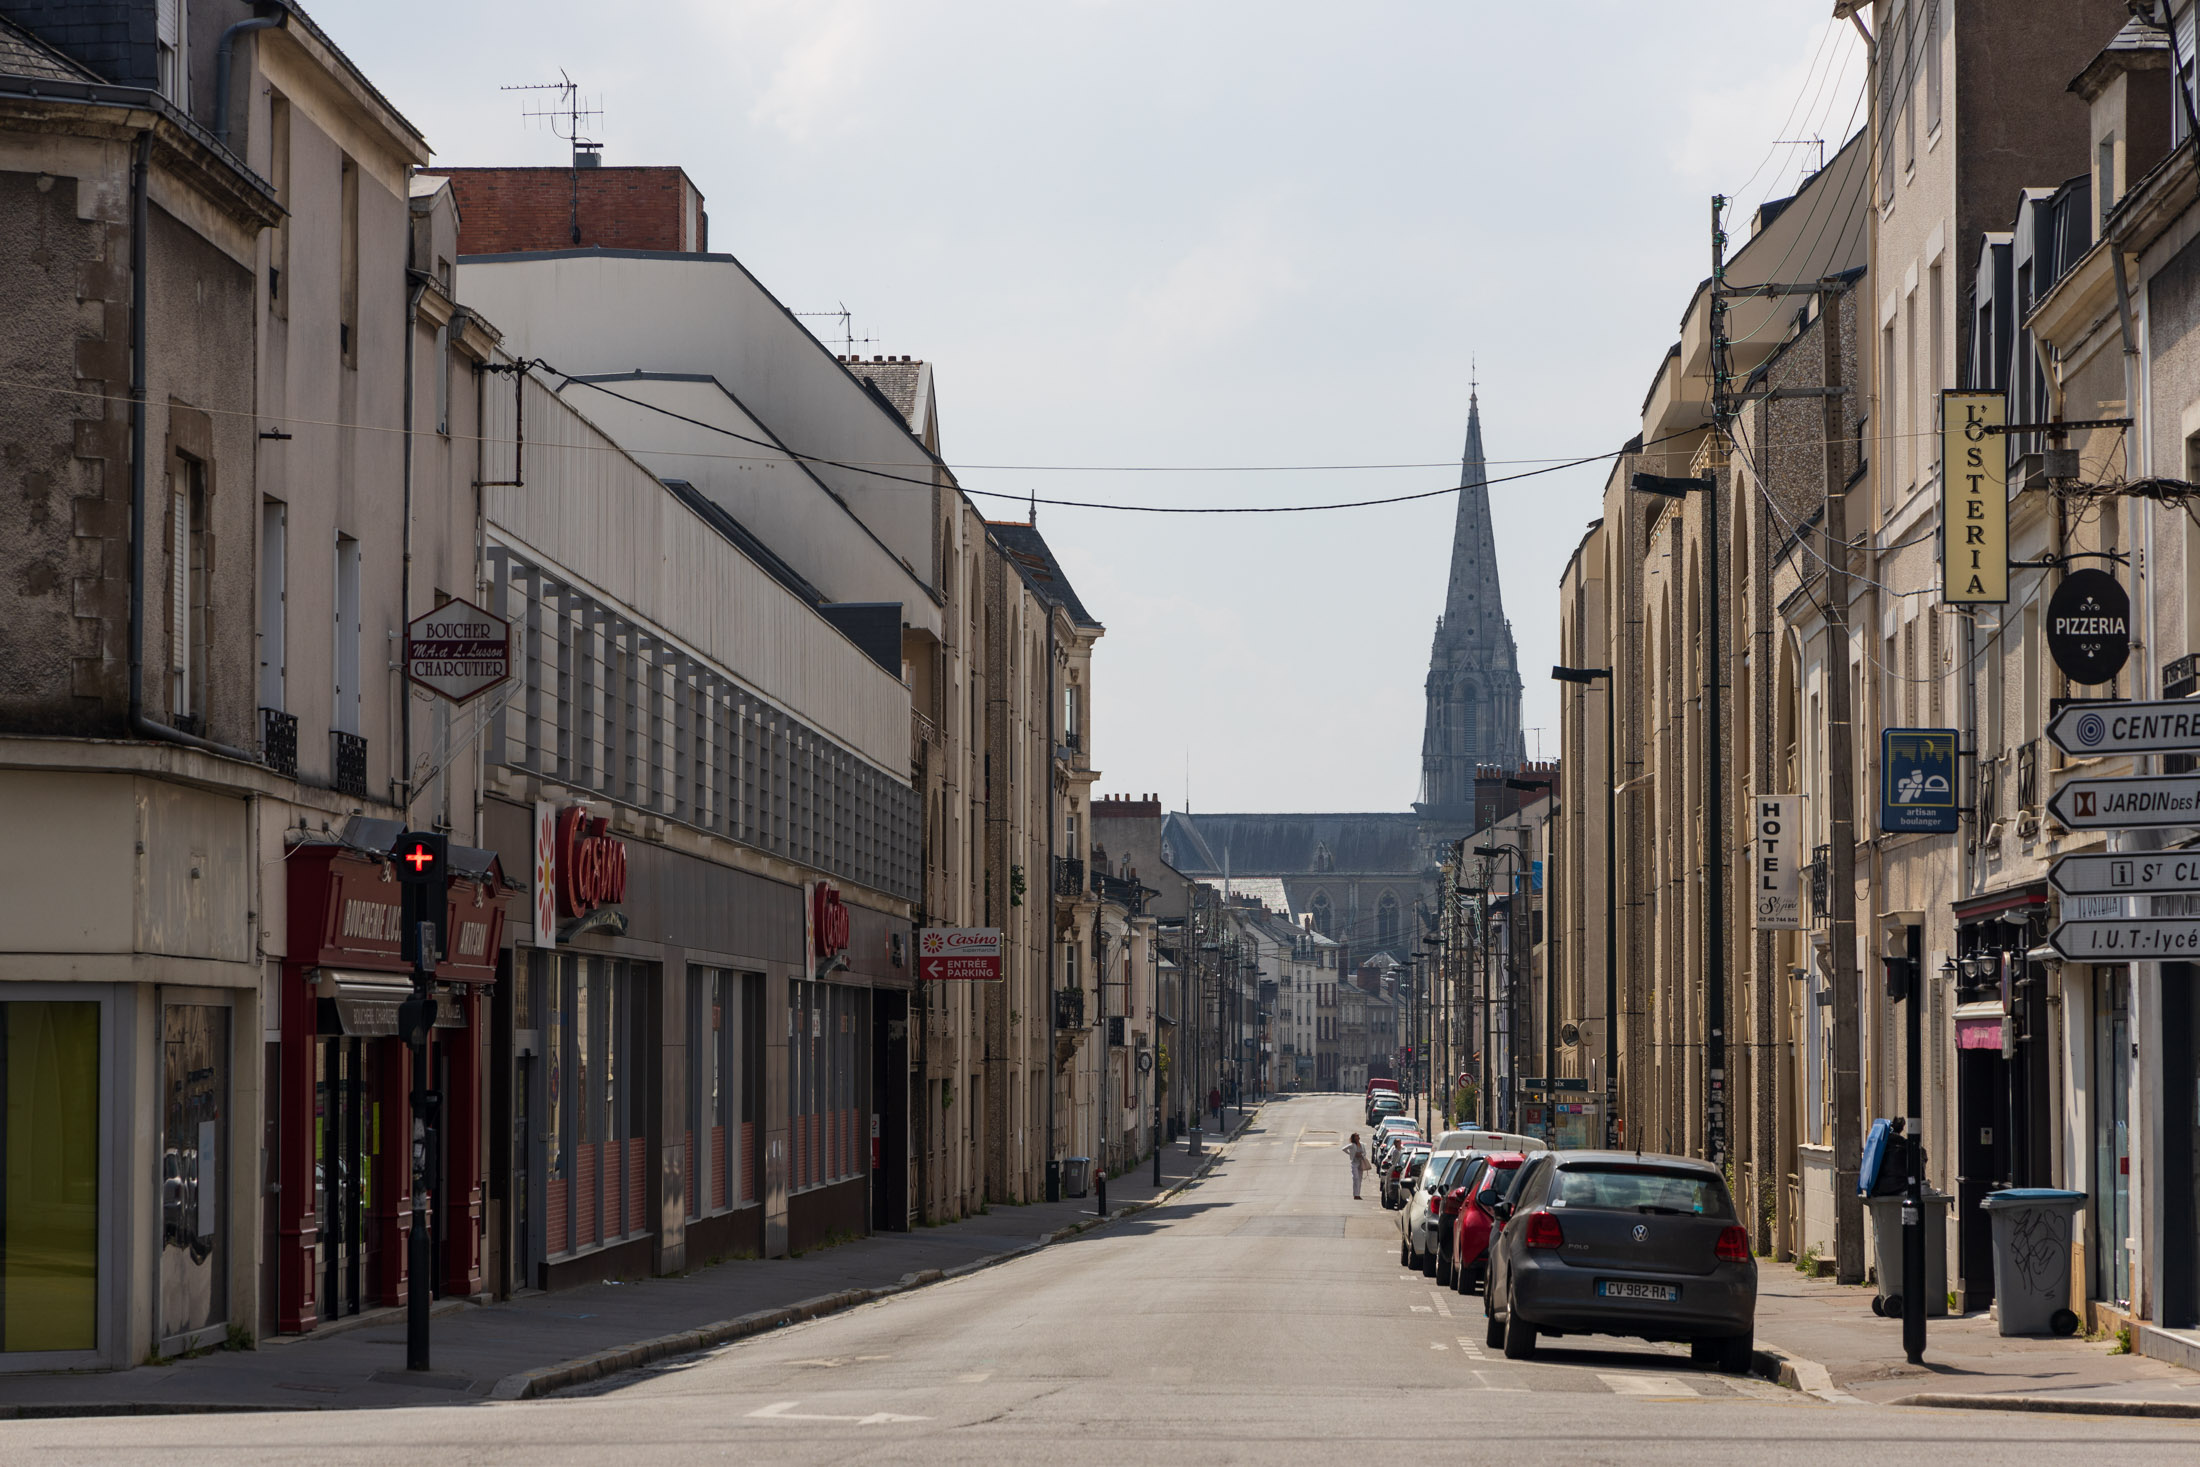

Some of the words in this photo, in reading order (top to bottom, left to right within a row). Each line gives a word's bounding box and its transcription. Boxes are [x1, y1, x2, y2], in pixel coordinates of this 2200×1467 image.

[1965, 405, 1988, 594] L'OSTERIA
[426, 623, 490, 639] BOUCHER
[2056, 617, 2126, 635] PIZZERIA
[466, 642, 503, 658] Lusson
[414, 661, 504, 677] CHARCUTIER
[2112, 713, 2200, 740] CENTRE
[2103, 792, 2171, 813] JARDIN
[2171, 798, 2193, 810] DES
[1906, 808, 1937, 816] artisan
[1900, 817, 1941, 827] boulanger
[1762, 803, 1781, 890] HOTEL
[557, 806, 627, 919] Casino
[2175, 862, 2199, 881] CL
[343, 899, 387, 940] BOUCHERIE
[815, 881, 850, 958] Casino
[458, 921, 487, 956] ARTISAN
[947, 933, 997, 947] Casino
[947, 958, 988, 969] ENTRÉE
[947, 968, 994, 977] PARKING
[1557, 1104, 1568, 1112] C1
